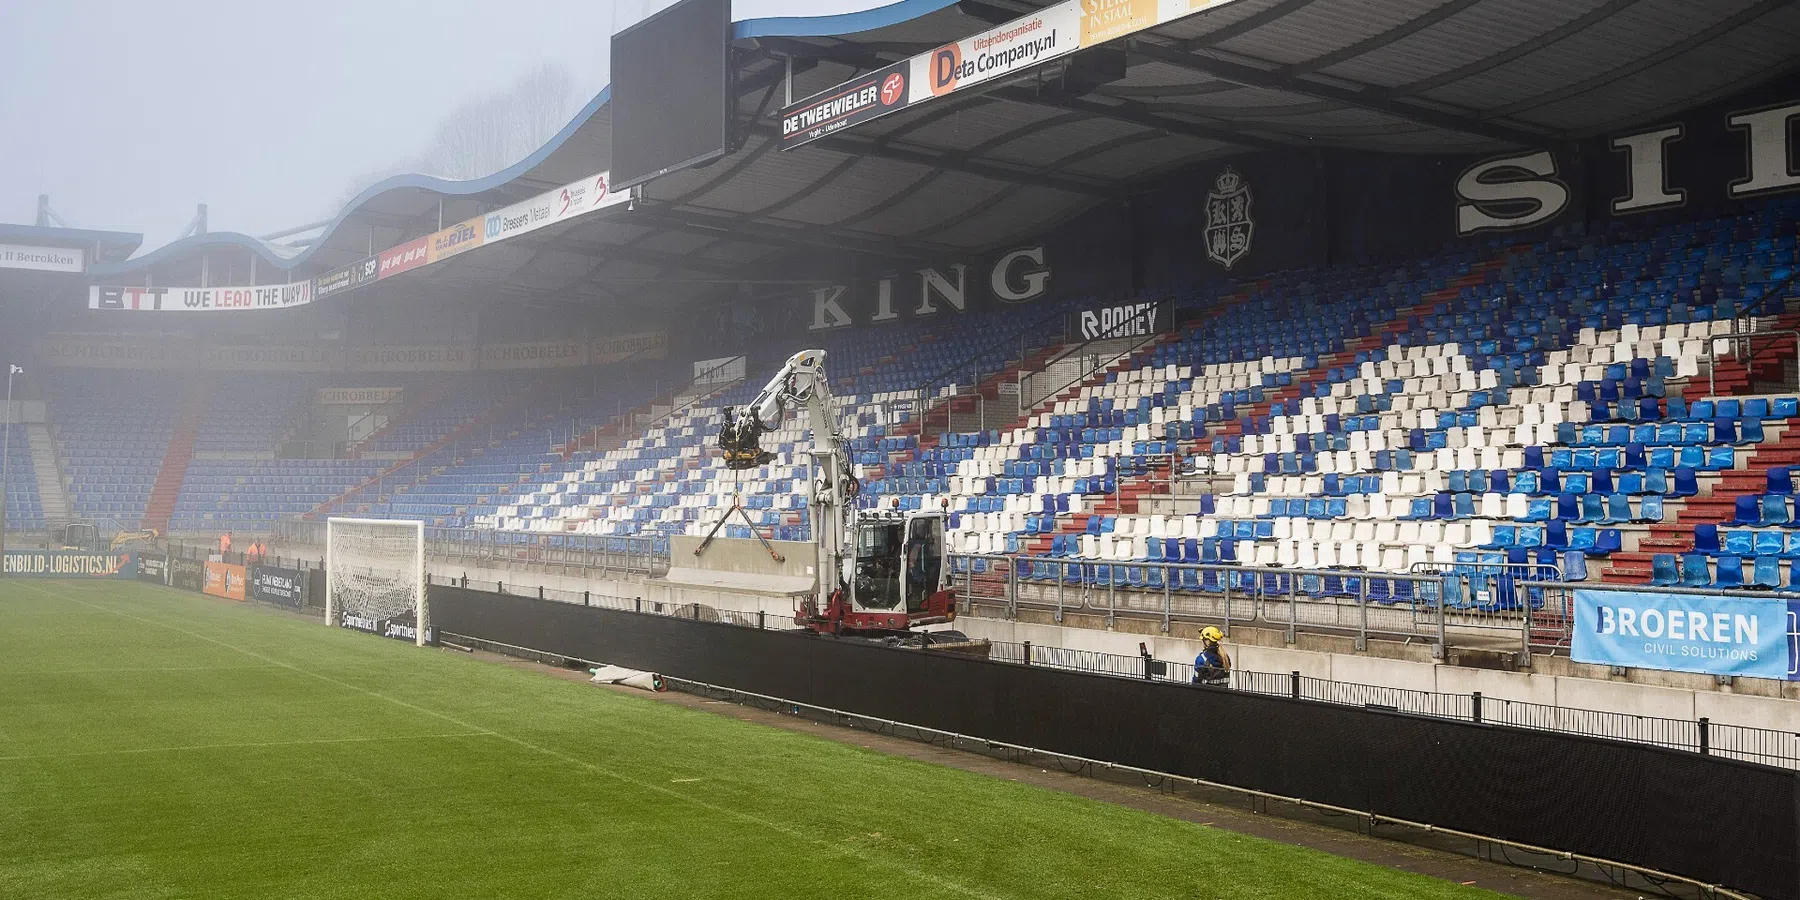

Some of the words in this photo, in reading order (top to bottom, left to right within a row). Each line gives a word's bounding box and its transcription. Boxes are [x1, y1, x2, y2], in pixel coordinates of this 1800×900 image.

[1090, 14, 1101, 28] IN
[1103, 3, 1133, 24] STAAL
[973, 17, 1043, 51] Uitzendorganisatie
[937, 49, 975, 88] Deta
[977, 28, 1056, 73] Company.nl
[784, 114, 799, 135] DE
[799, 85, 878, 129] TWEEWIELER
[502, 212, 529, 233] Bressers
[448, 225, 477, 247] RIEL
[17, 252, 74, 265] Betrokken
[98, 286, 169, 309] BTT
[184, 290, 211, 308] WE
[214, 289, 253, 308] LEAD
[255, 288, 279, 306] THE
[281, 286, 301, 305] WAY
[807, 243, 1052, 332] KING
[391, 621, 432, 642] sportnieunl
[1595, 605, 1760, 646] BROEREN
[1644, 642, 1676, 657] CIVIL
[1681, 645, 1758, 662] SOLUTIONS
